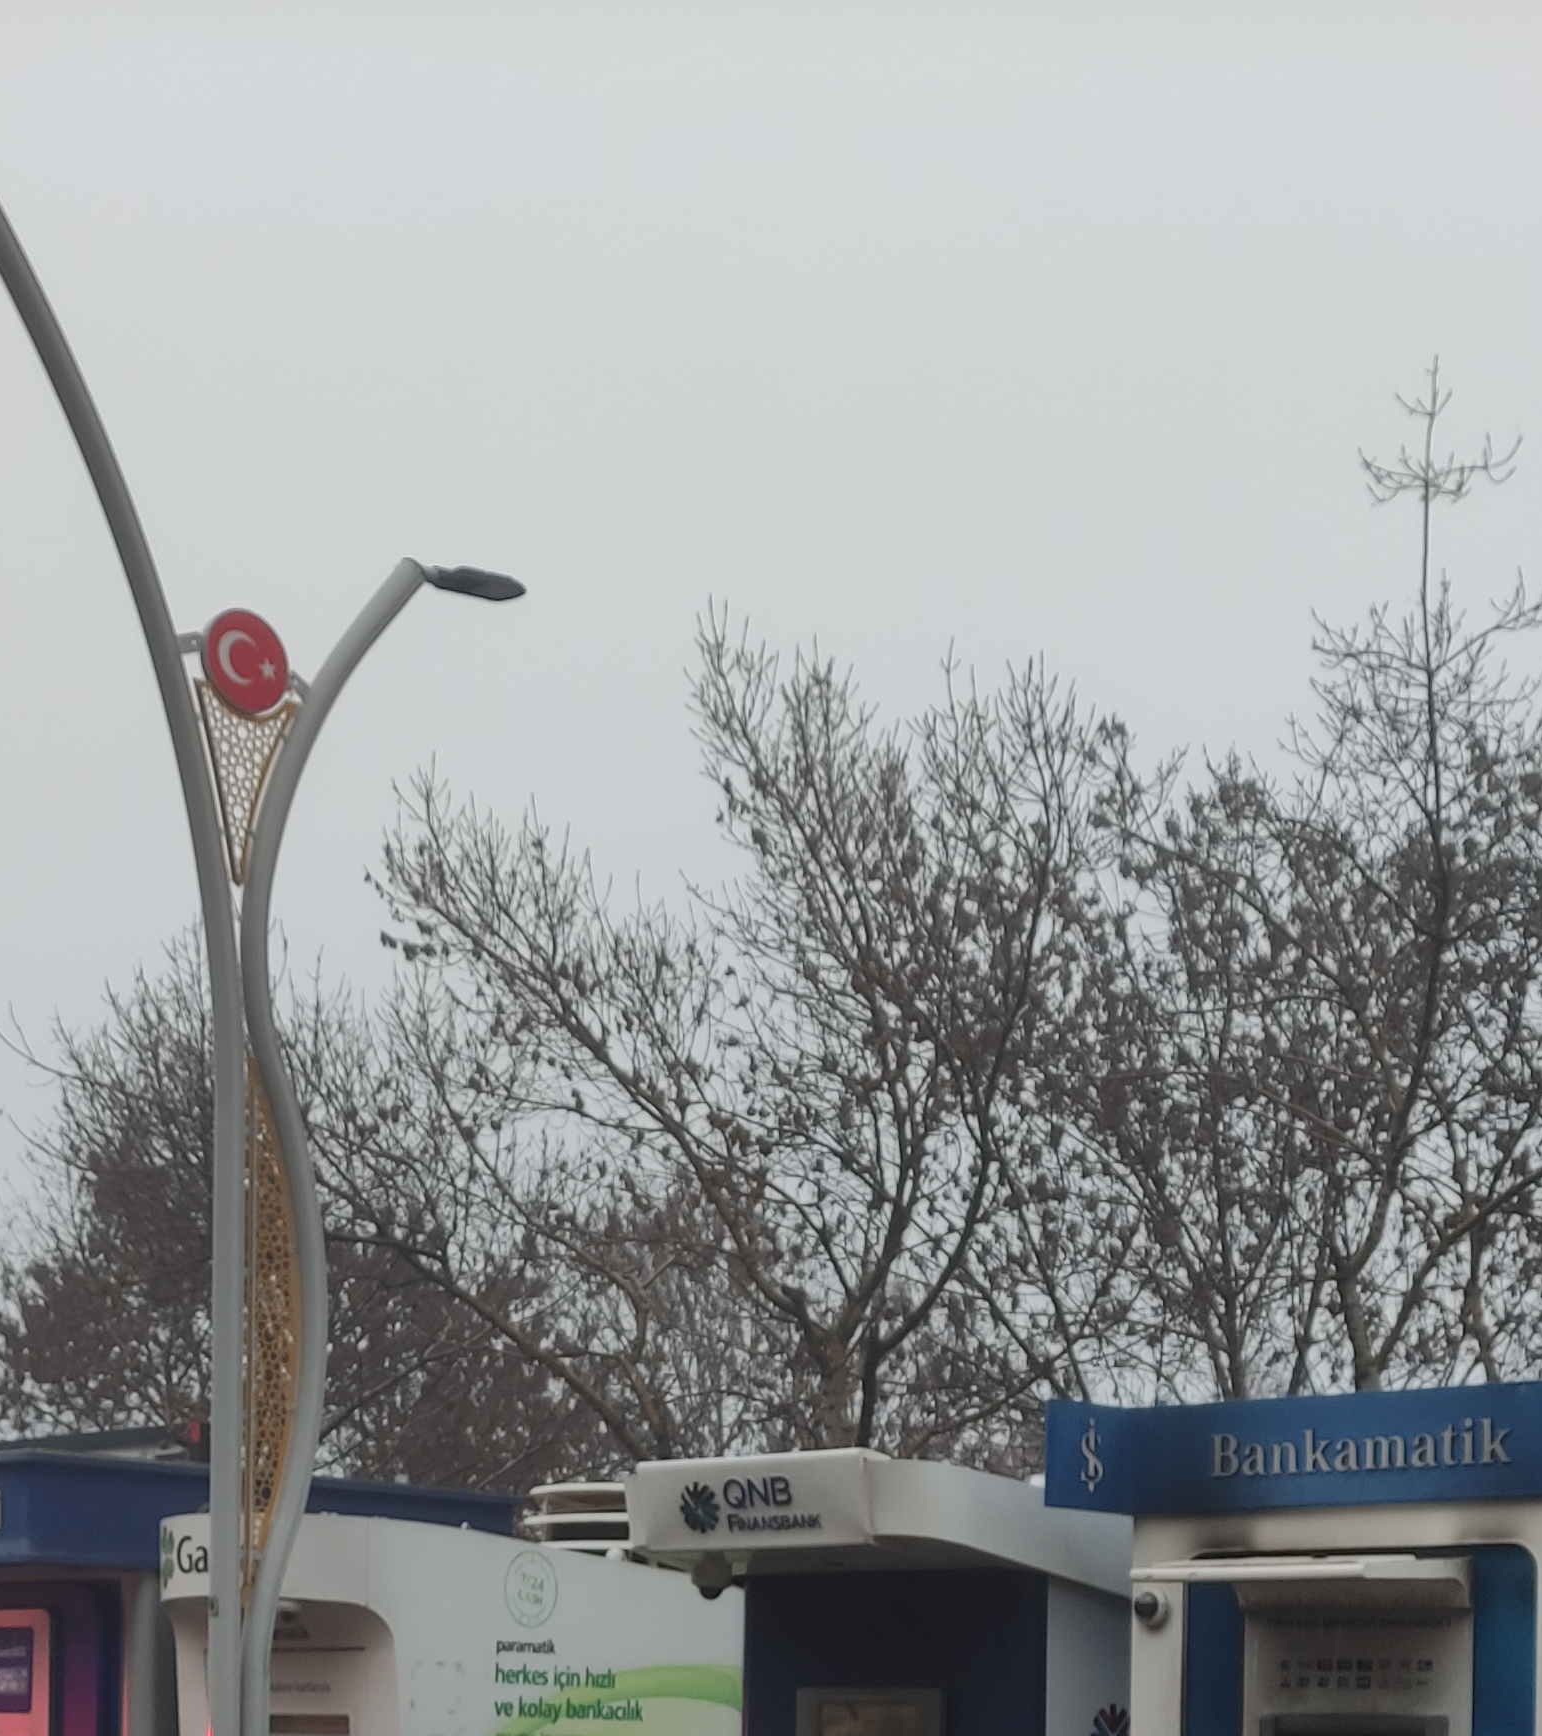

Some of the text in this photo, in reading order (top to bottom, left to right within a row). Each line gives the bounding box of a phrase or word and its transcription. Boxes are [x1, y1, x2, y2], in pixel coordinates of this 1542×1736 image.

[1210, 1416, 1513, 1479] Bankamatik
[723, 1476, 793, 1509] QNB
[496, 1639, 556, 1655] paramatik
[495, 1661, 616, 1691] herkes için hızlı
[494, 1695, 644, 1724] ve kolay bankacılık
